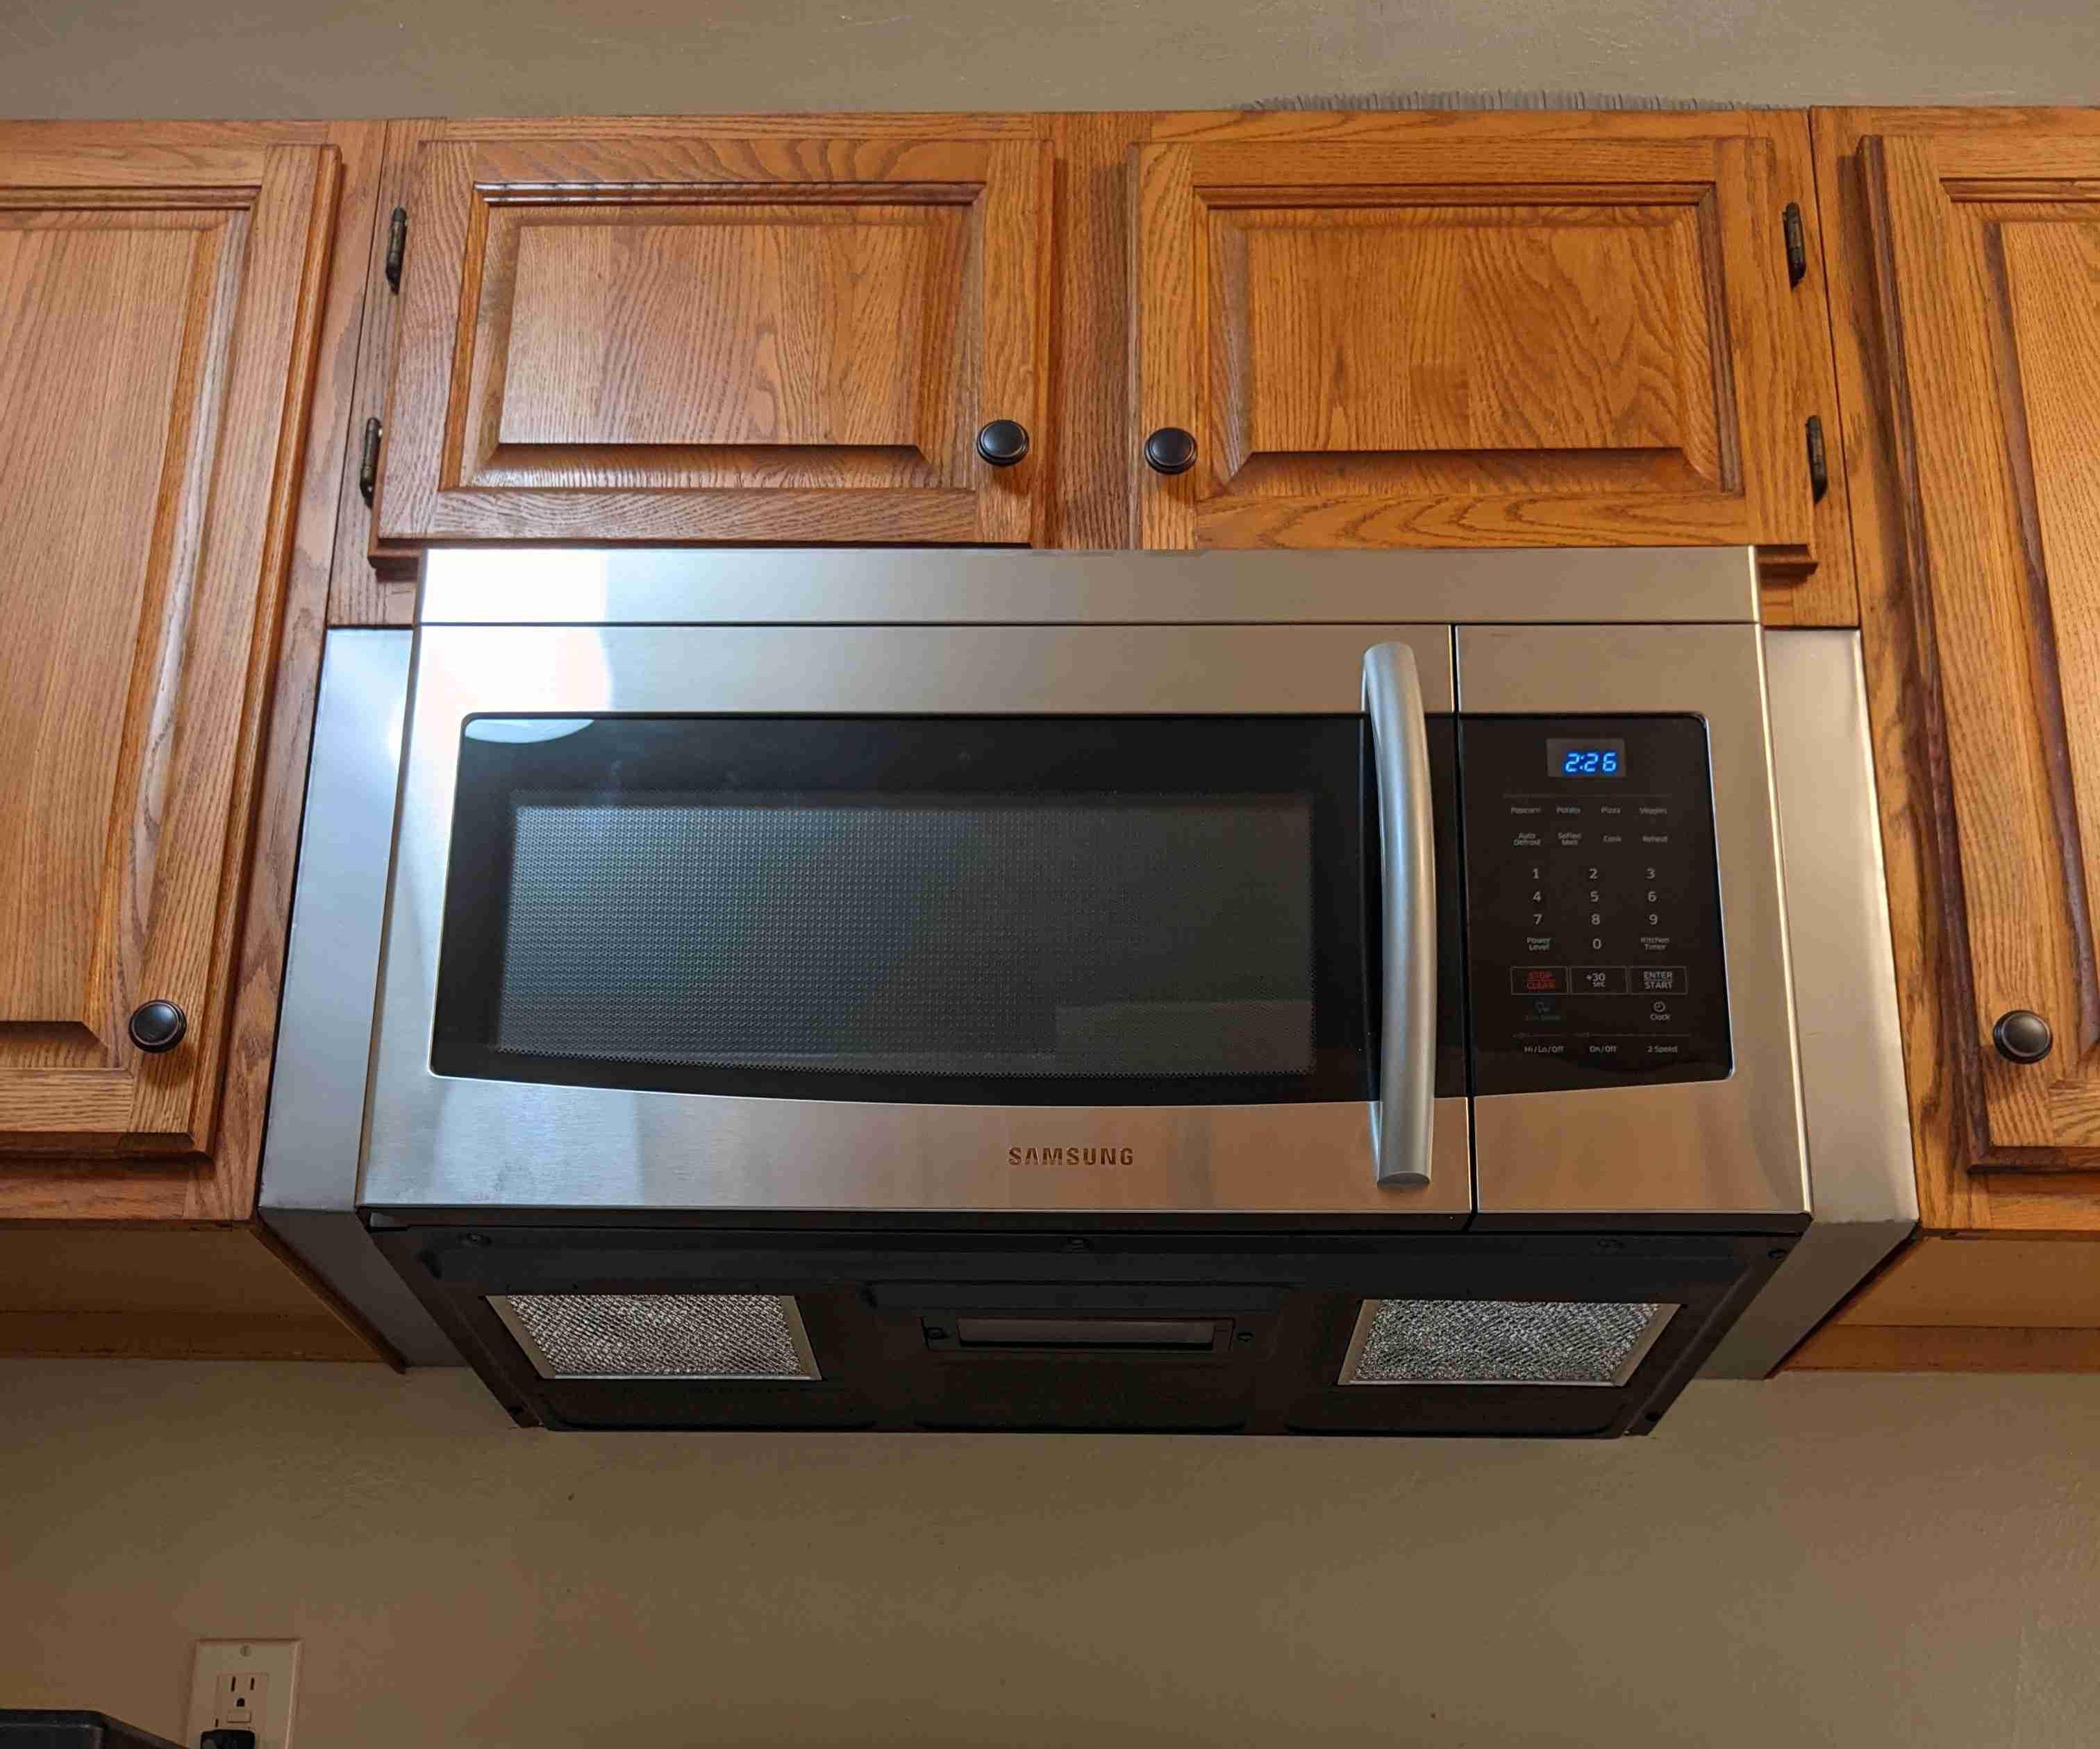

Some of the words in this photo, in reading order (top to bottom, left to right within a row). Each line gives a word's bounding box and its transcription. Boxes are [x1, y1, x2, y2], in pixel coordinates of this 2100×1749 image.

[1565, 752, 1617, 773] 2:26
[1533, 869, 1540, 879] 1
[1589, 869, 1598, 879] 2
[1647, 869, 1656, 879] 3
[1533, 892, 1542, 902] 4
[1590, 892, 1599, 902] 5
[1648, 892, 1656, 902] 6
[1533, 914, 1542, 925] 7
[1591, 914, 1601, 925] 8
[1649, 914, 1658, 925] 9
[1592, 939, 1601, 949] 0
[1643, 971, 1673, 980] ENTER
[1644, 981, 1674, 989] START
[1008, 1147, 1134, 1165] SAMSUNG
